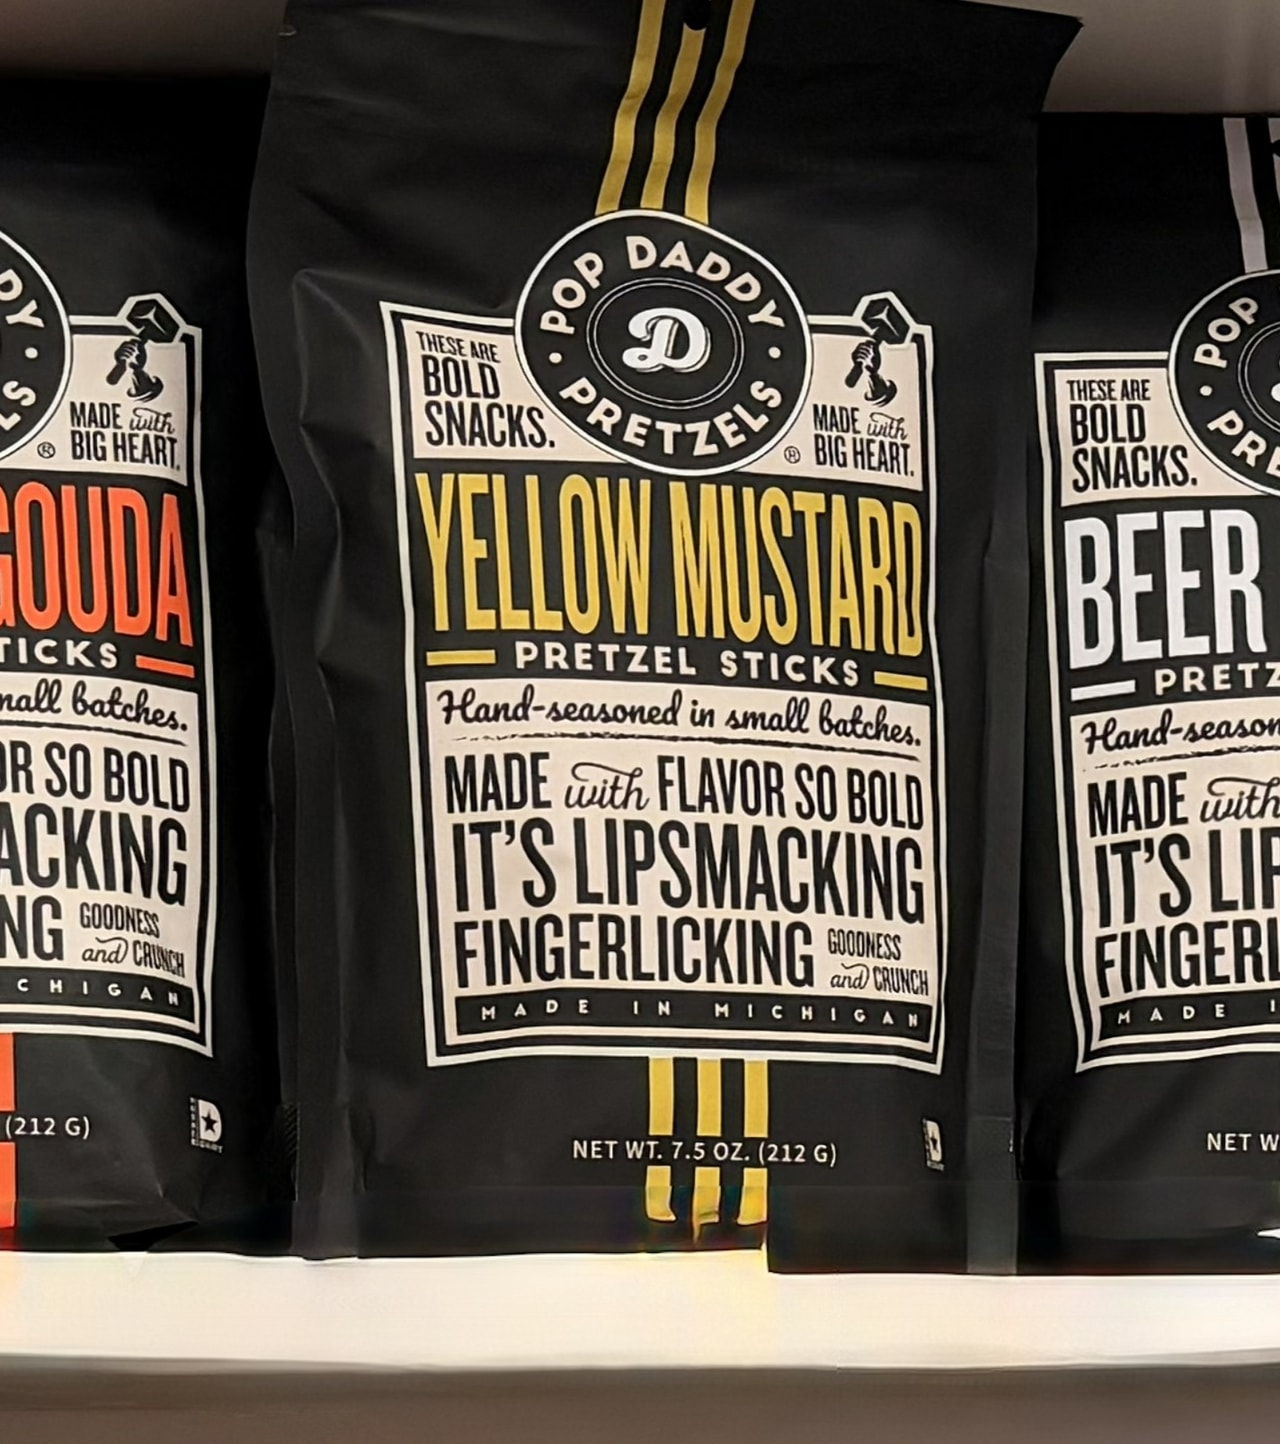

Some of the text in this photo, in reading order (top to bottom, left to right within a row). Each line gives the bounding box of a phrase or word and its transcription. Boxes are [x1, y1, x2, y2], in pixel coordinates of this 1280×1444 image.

[539, 235, 786, 335] POP DADDY
[1193, 296, 1260, 369] POP
[559, 377, 783, 457] PRETZELS
[813, 404, 908, 441] MADE with
[813, 435, 915, 476] BIG HEART.
[415, 472, 924, 657] YELLOW MUSTARD
[1064, 508, 1267, 670] BEER
[515, 641, 860, 687] PRETZEL STICKS
[44, 741, 92, 800] SO
[103, 747, 190, 813] BOLD
[1087, 772, 1188, 837] MADE
[573, 818, 924, 924] LIPSMACKING
[79, 902, 160, 939] GOODNESS
[453, 914, 814, 988] FINGERLICKING
[81, 936, 185, 978] and CRUNCH
[481, 999, 919, 1028] MADE IN MICHIGAN
[1117, 1004, 1225, 1024] MADE
